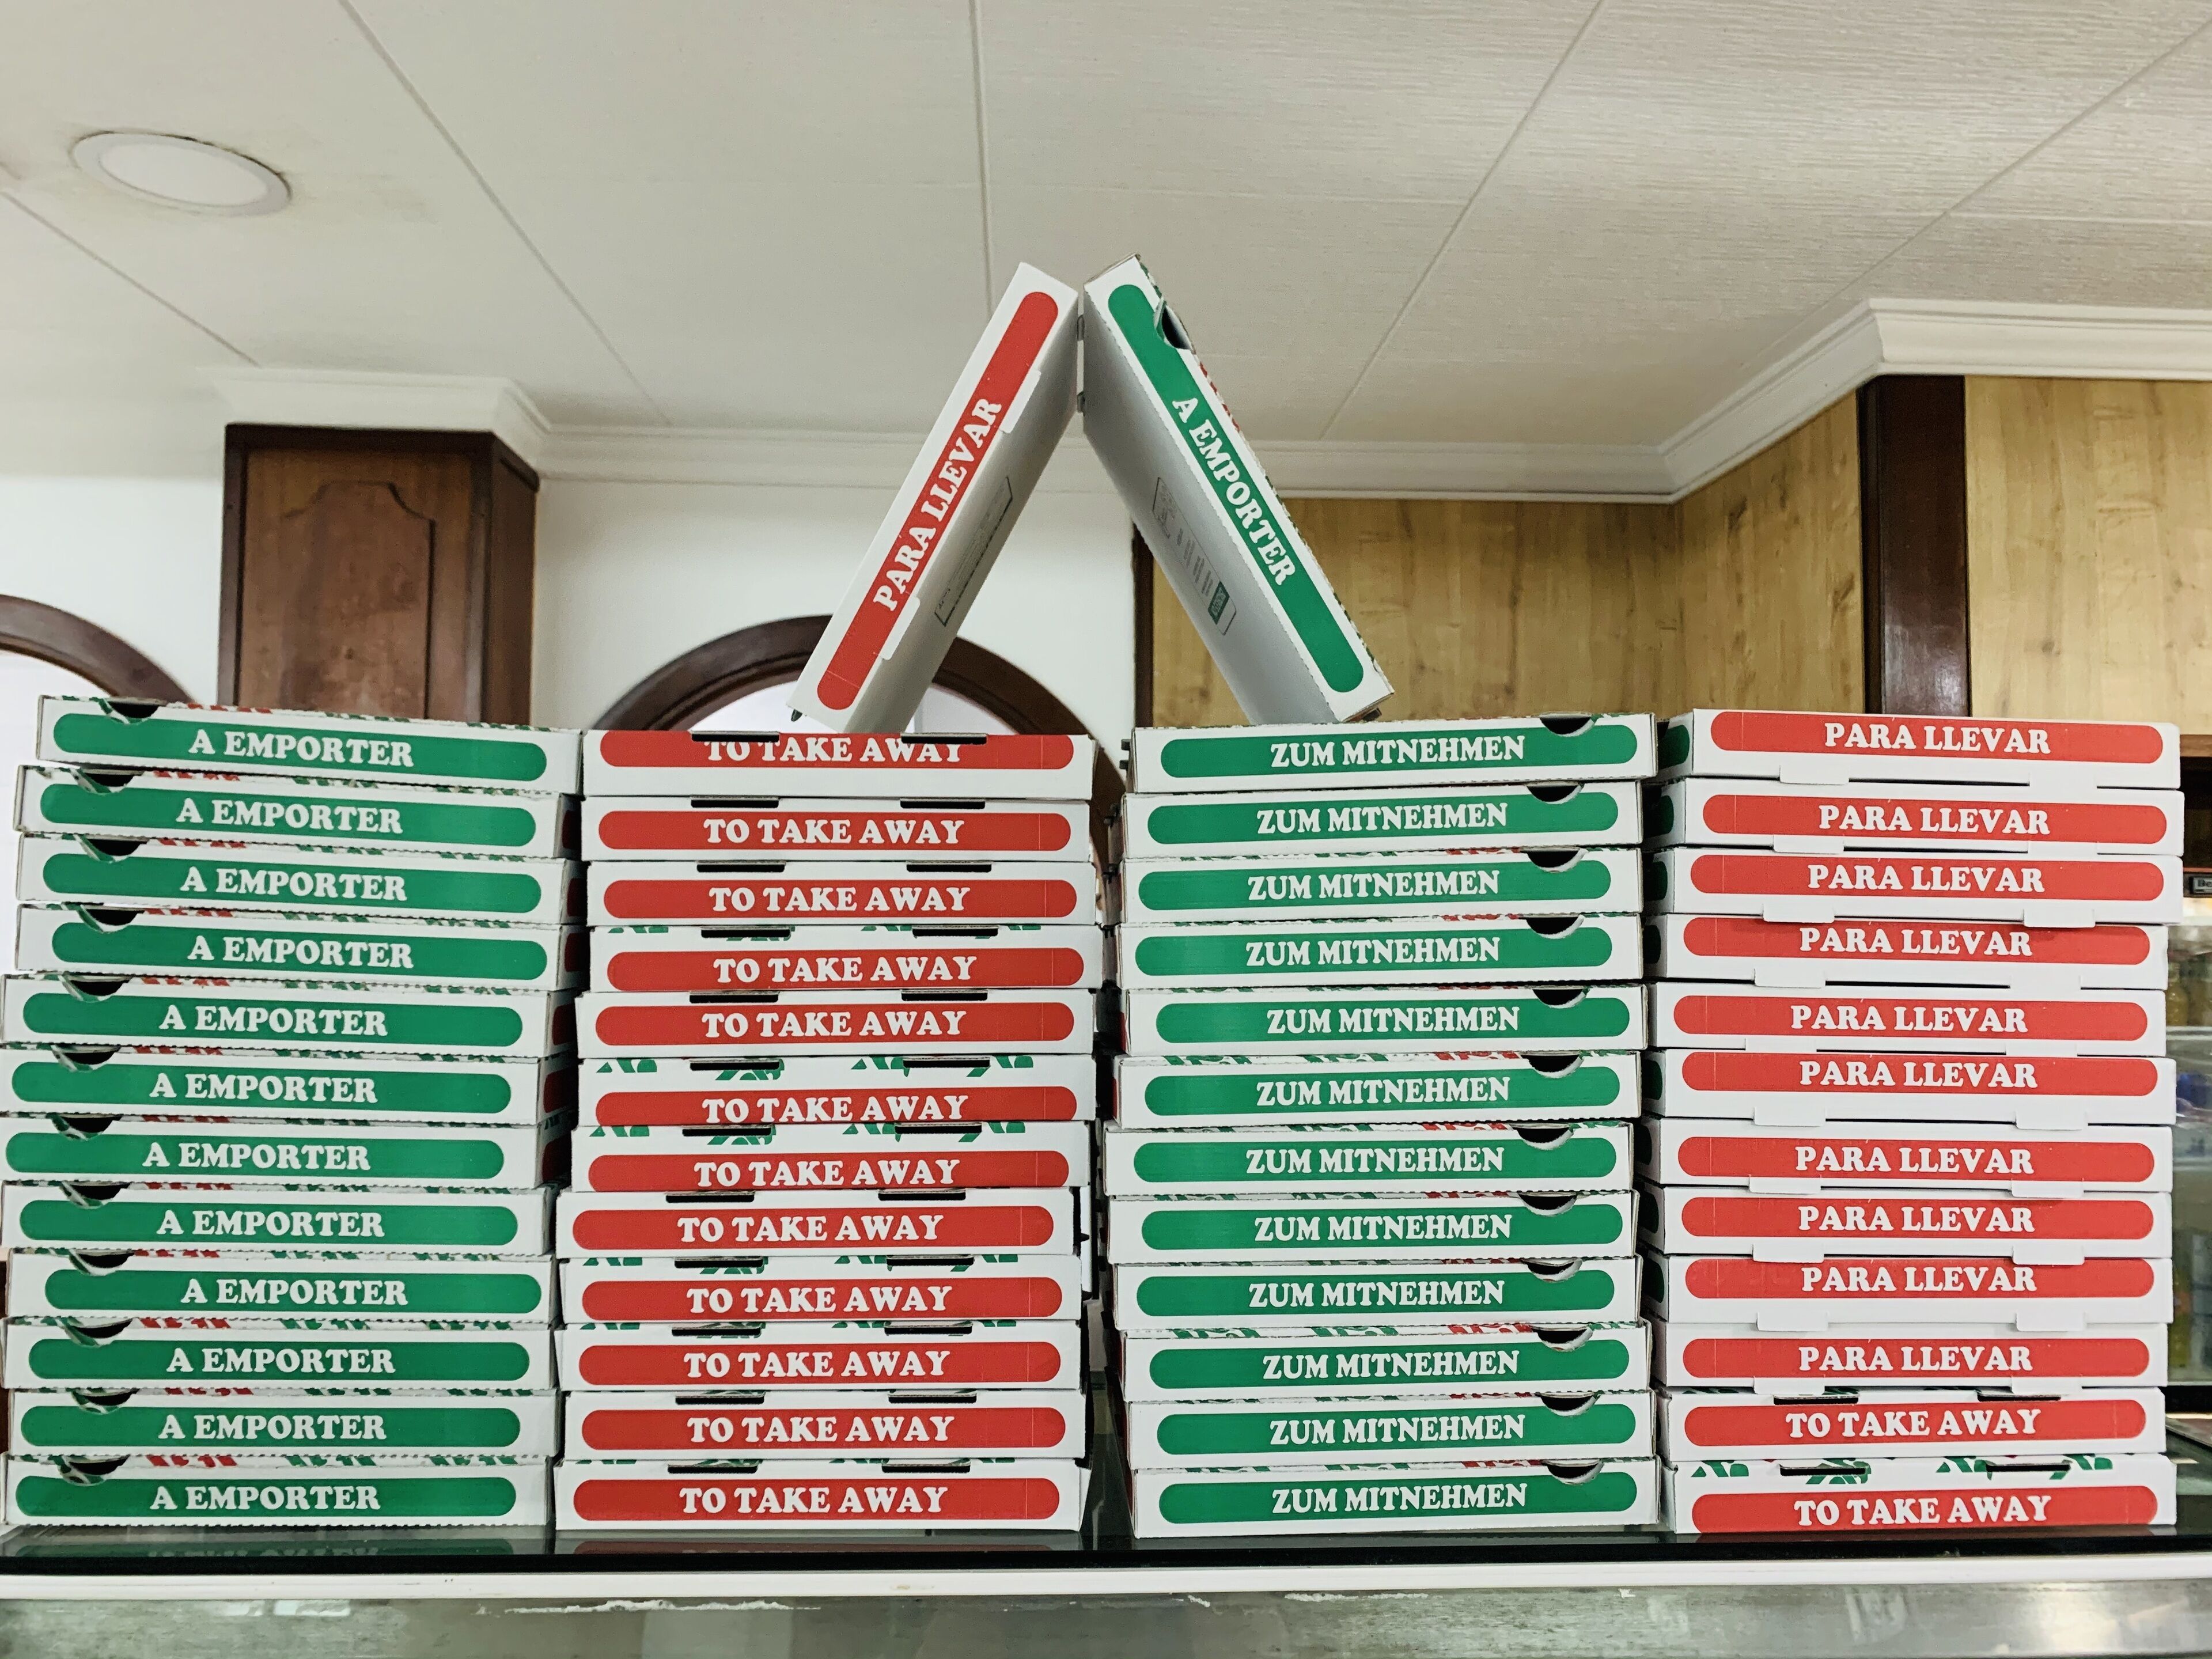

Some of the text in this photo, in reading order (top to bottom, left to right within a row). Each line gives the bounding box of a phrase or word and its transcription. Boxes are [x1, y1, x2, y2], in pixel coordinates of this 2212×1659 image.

[872, 527, 937, 612] PARA
[921, 399, 1003, 522] LLEVAR
[1172, 397, 1199, 423] A
[1188, 419, 1296, 586] EMPORTER
[188, 729, 414, 767] A EMPORTER
[703, 737, 961, 763] TO TAKE AWAY
[1270, 735, 1525, 768] ZUM MITNEHMEN
[1824, 722, 2051, 754] PARA LLEVAR
[175, 797, 403, 834] A EMPORTER
[1256, 802, 1508, 834] ZUM MITNEHMEN
[1819, 805, 2050, 835] PARA LLEVAR
[703, 819, 965, 844] TO TAKE AWAY
[179, 866, 408, 902] A EMPORTER
[1248, 869, 1500, 900] ZUM MITNEHMEN
[1808, 864, 2045, 893] PARA LLEVAR
[709, 887, 971, 912] TO TAKE AWAY
[187, 935, 414, 969] A EMPORTER
[1245, 937, 1501, 967] ZUM MITNEHMEN
[1800, 927, 2033, 956] PARA LLEVAR
[713, 956, 977, 983] TO TAKE AWAY
[158, 1004, 388, 1036] A EMPORTER
[701, 1010, 967, 1038] TO TAKE AWAY
[1266, 1006, 1520, 1034] ZUM MITNEHMEN
[1790, 1005, 2028, 1033] PARA LLEVAR
[149, 1072, 378, 1104] A EMPORTER
[1800, 1060, 2038, 1088] PARA LLEVAR
[1256, 1076, 1510, 1107] ZUM MITNEHMEN
[702, 1095, 968, 1124] TO TAKE AWAY
[142, 1142, 371, 1171] A EMPORTER
[1245, 1146, 1505, 1174] ZUM MITNEHMEN
[1795, 1146, 2035, 1174] PARA LLEVAR
[694, 1159, 960, 1187] TO TAKE AWAY
[156, 1210, 385, 1237] A EMPORTER
[677, 1214, 944, 1243] TO TAKE AWAY
[1254, 1214, 1513, 1241] ZUM MITNEHMEN
[1798, 1206, 2035, 1232] PARA LLEVAR
[180, 1278, 408, 1306] A EMPORTER
[1801, 1266, 2037, 1292] PARA LLEVAR
[686, 1286, 952, 1313] TO TAKE AWAY
[1248, 1280, 1505, 1308] ZUM MITNEHMEN
[166, 1347, 396, 1373] A EMPORTER
[683, 1350, 950, 1378] TO TAKE AWAY
[1262, 1350, 1520, 1380] ZUM MITNEHMEN
[1798, 1346, 2033, 1371] PARA LLEVAR
[158, 1414, 387, 1440] A EMPORTER
[687, 1416, 955, 1443] TO TAKE AWAY
[1270, 1414, 1525, 1445] ZUM MITNEHMEN
[1785, 1408, 2041, 1438] TO TAKE AWAY
[150, 1485, 381, 1510] A EMPORTER
[679, 1487, 948, 1514] TO TAKE AWAY
[1272, 1483, 1528, 1514] ZUM MITNEHMEN
[1794, 1495, 2051, 1526] TO TAKE AWAY
